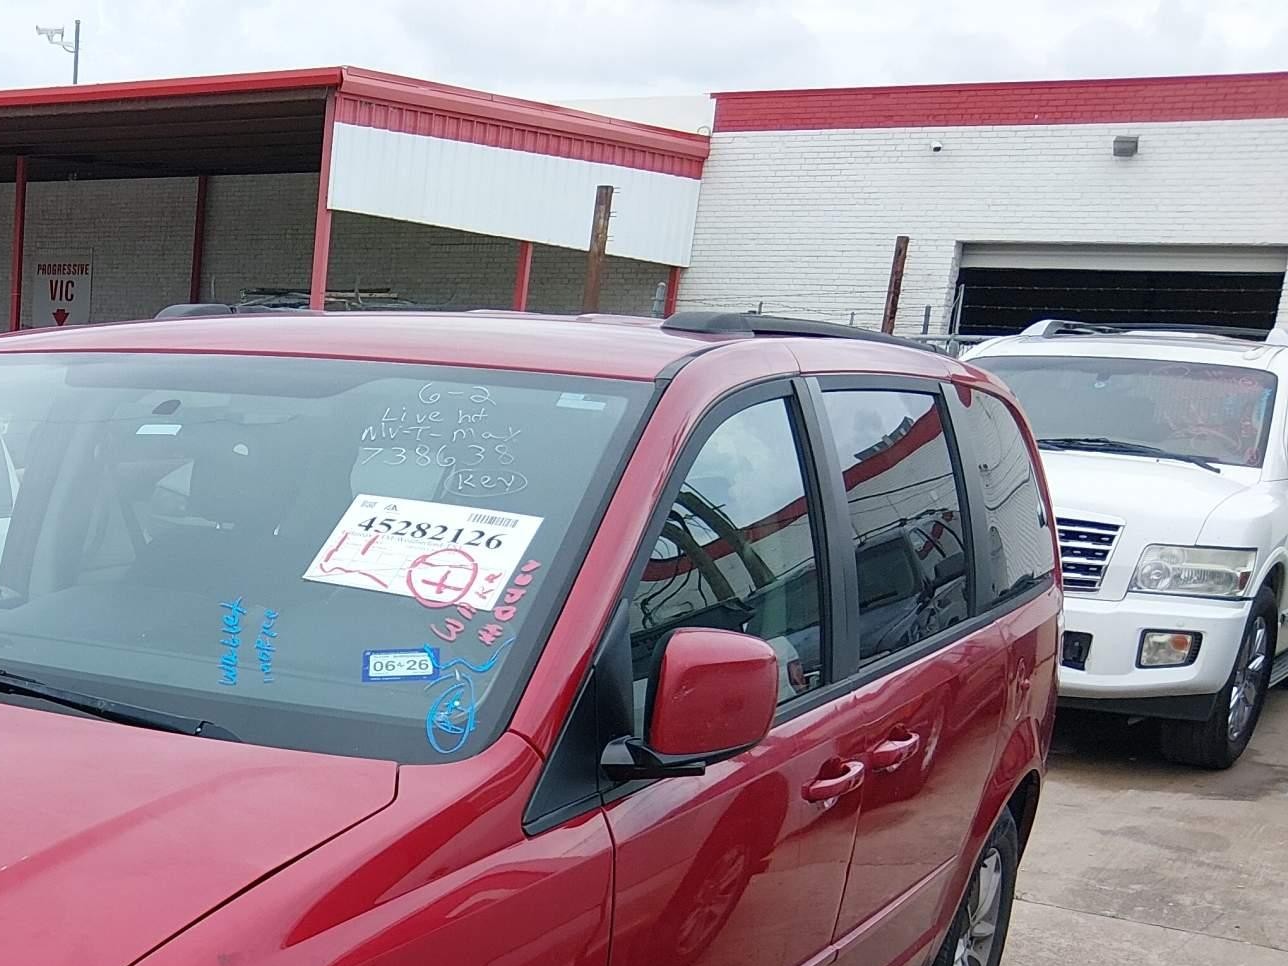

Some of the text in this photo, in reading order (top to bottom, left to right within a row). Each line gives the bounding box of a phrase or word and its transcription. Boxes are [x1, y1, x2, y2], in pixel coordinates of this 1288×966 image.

[37, 263, 90, 276] PROGRESSIVE
[49, 279, 75, 302] VIC
[361, 444, 515, 467] 738638
[357, 516, 508, 550] 45282126
